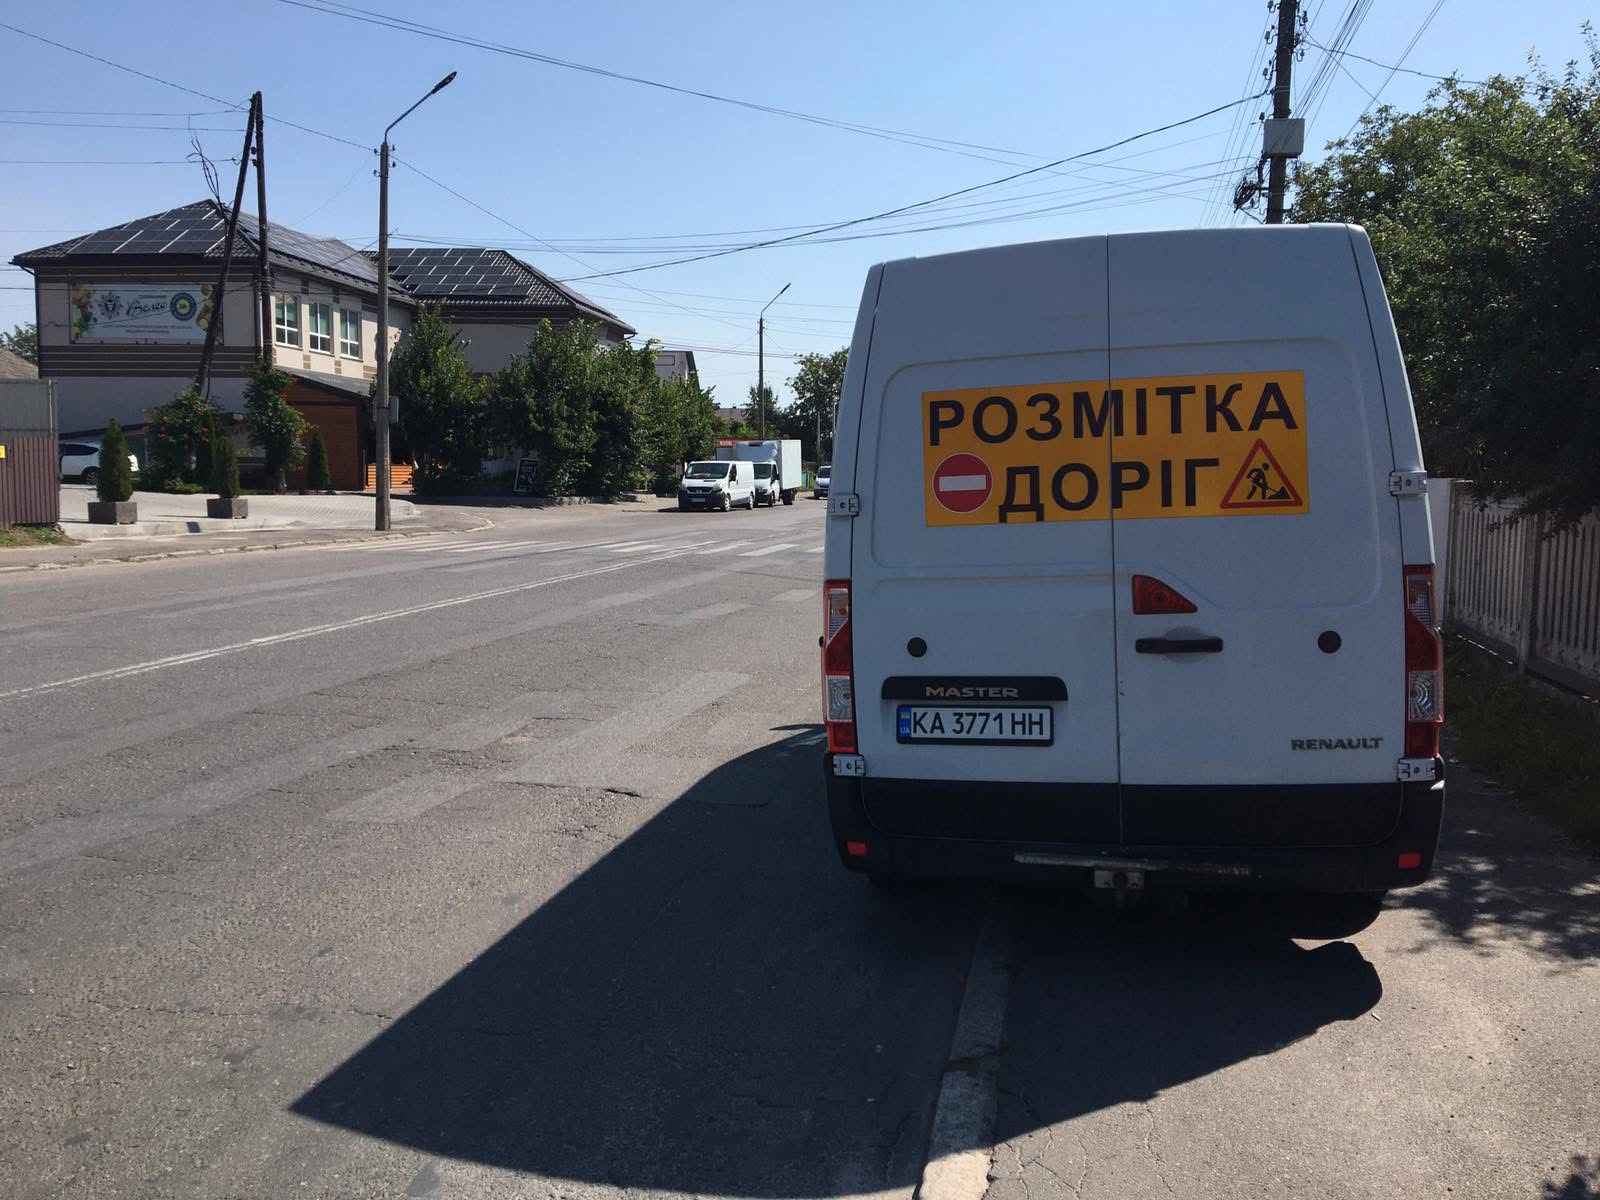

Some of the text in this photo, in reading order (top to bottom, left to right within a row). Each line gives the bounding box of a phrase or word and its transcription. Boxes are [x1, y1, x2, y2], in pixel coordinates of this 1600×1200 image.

[929, 382, 1298, 446] РОЗМІТКА
[999, 458, 1220, 523] ДОРІГ
[925, 686, 1019, 698] MASTER
[1291, 737, 1384, 751] RENAULT
